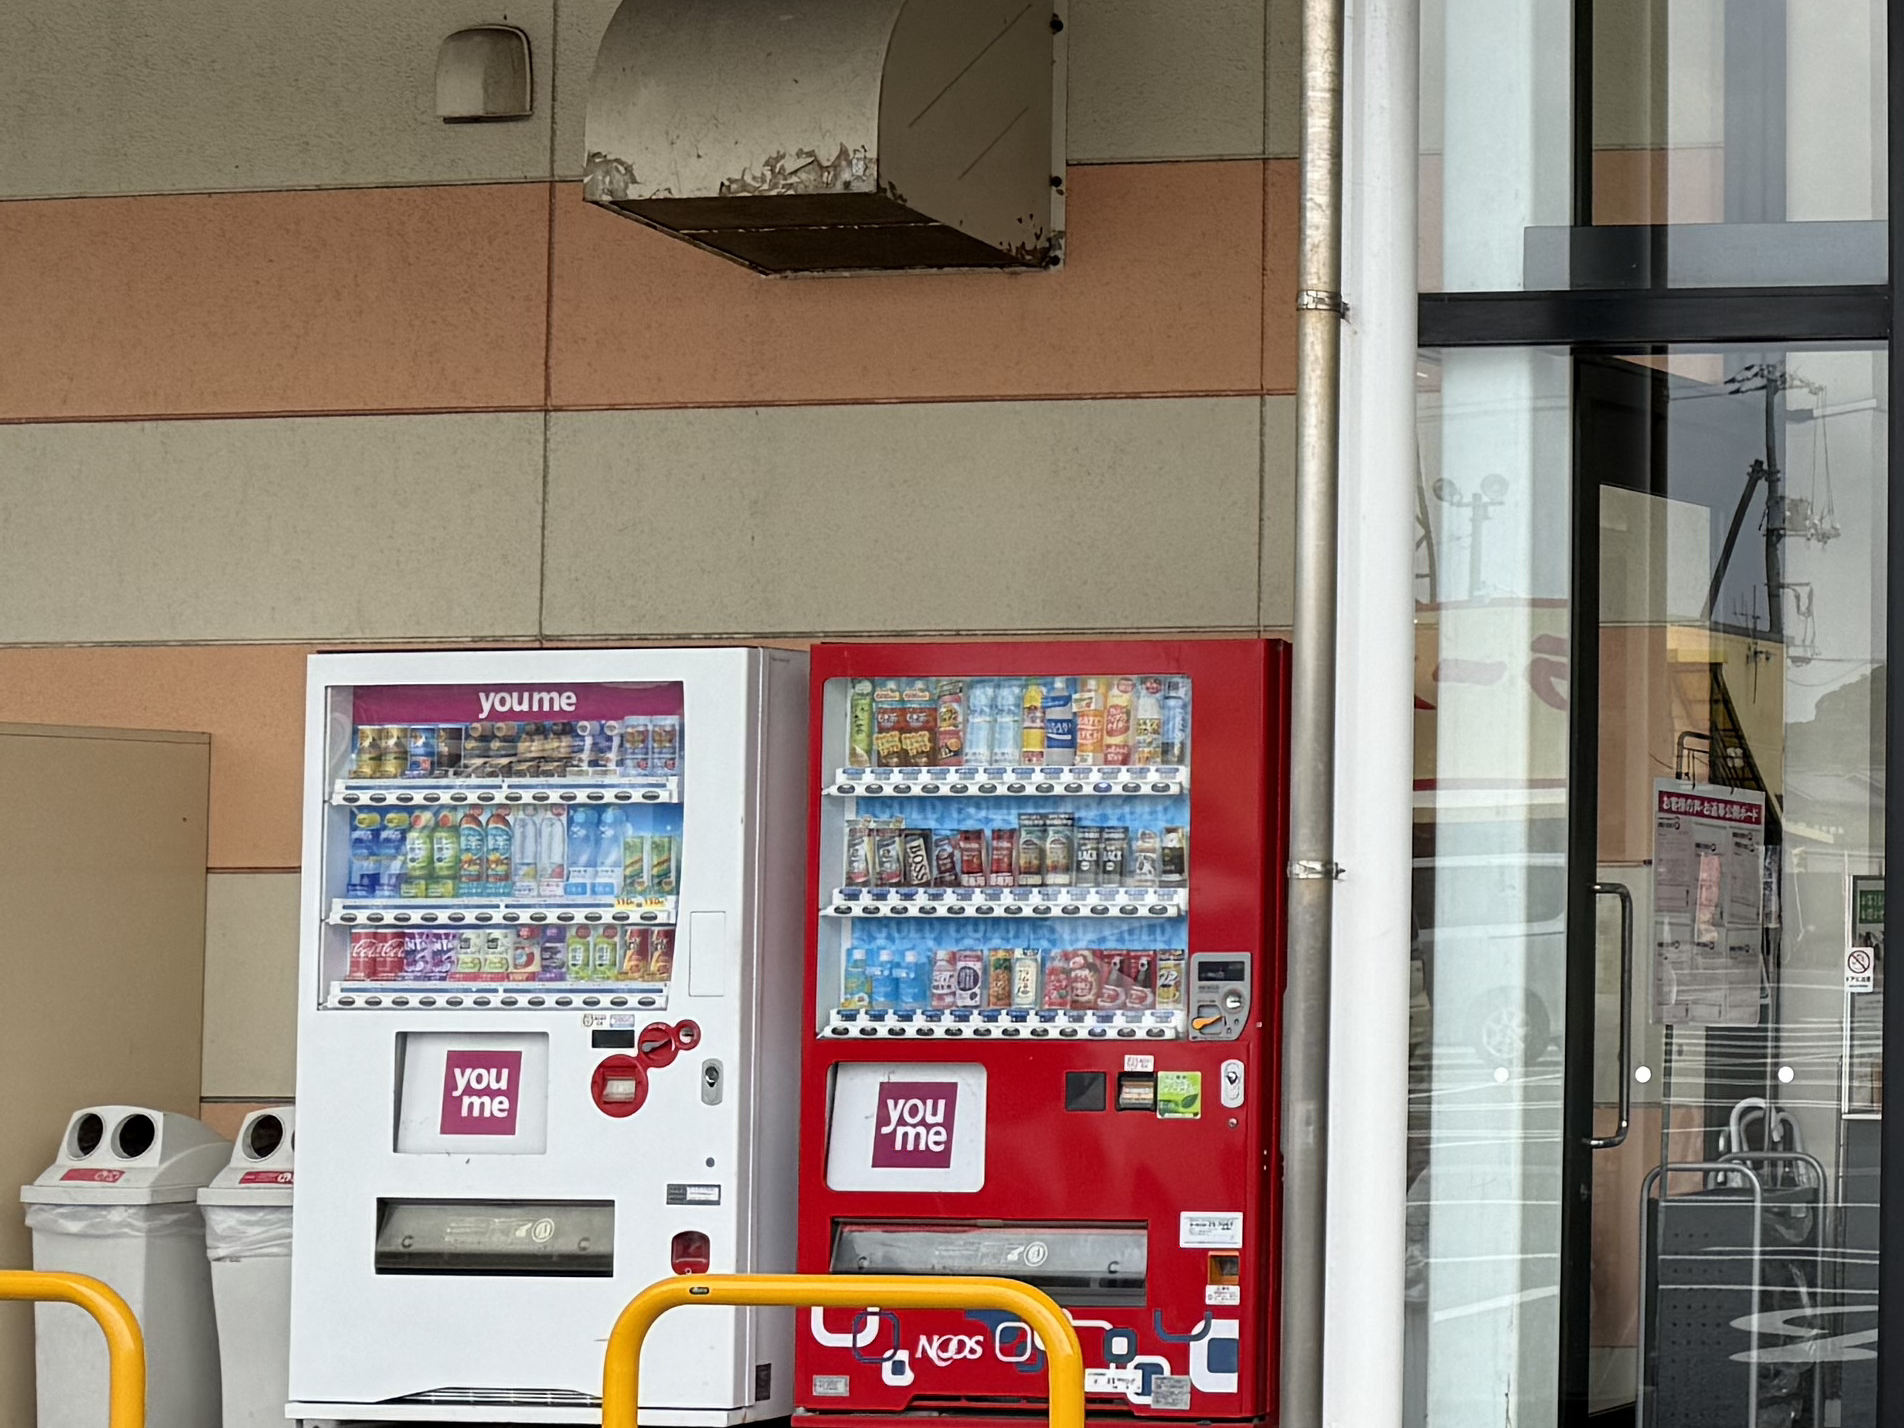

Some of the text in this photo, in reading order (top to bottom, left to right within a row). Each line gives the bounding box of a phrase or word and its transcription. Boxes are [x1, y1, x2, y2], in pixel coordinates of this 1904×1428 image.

[453, 1066, 509, 1097] you
[461, 1092, 509, 1118] me
[881, 1098, 946, 1133] you
[895, 1125, 947, 1152] me
